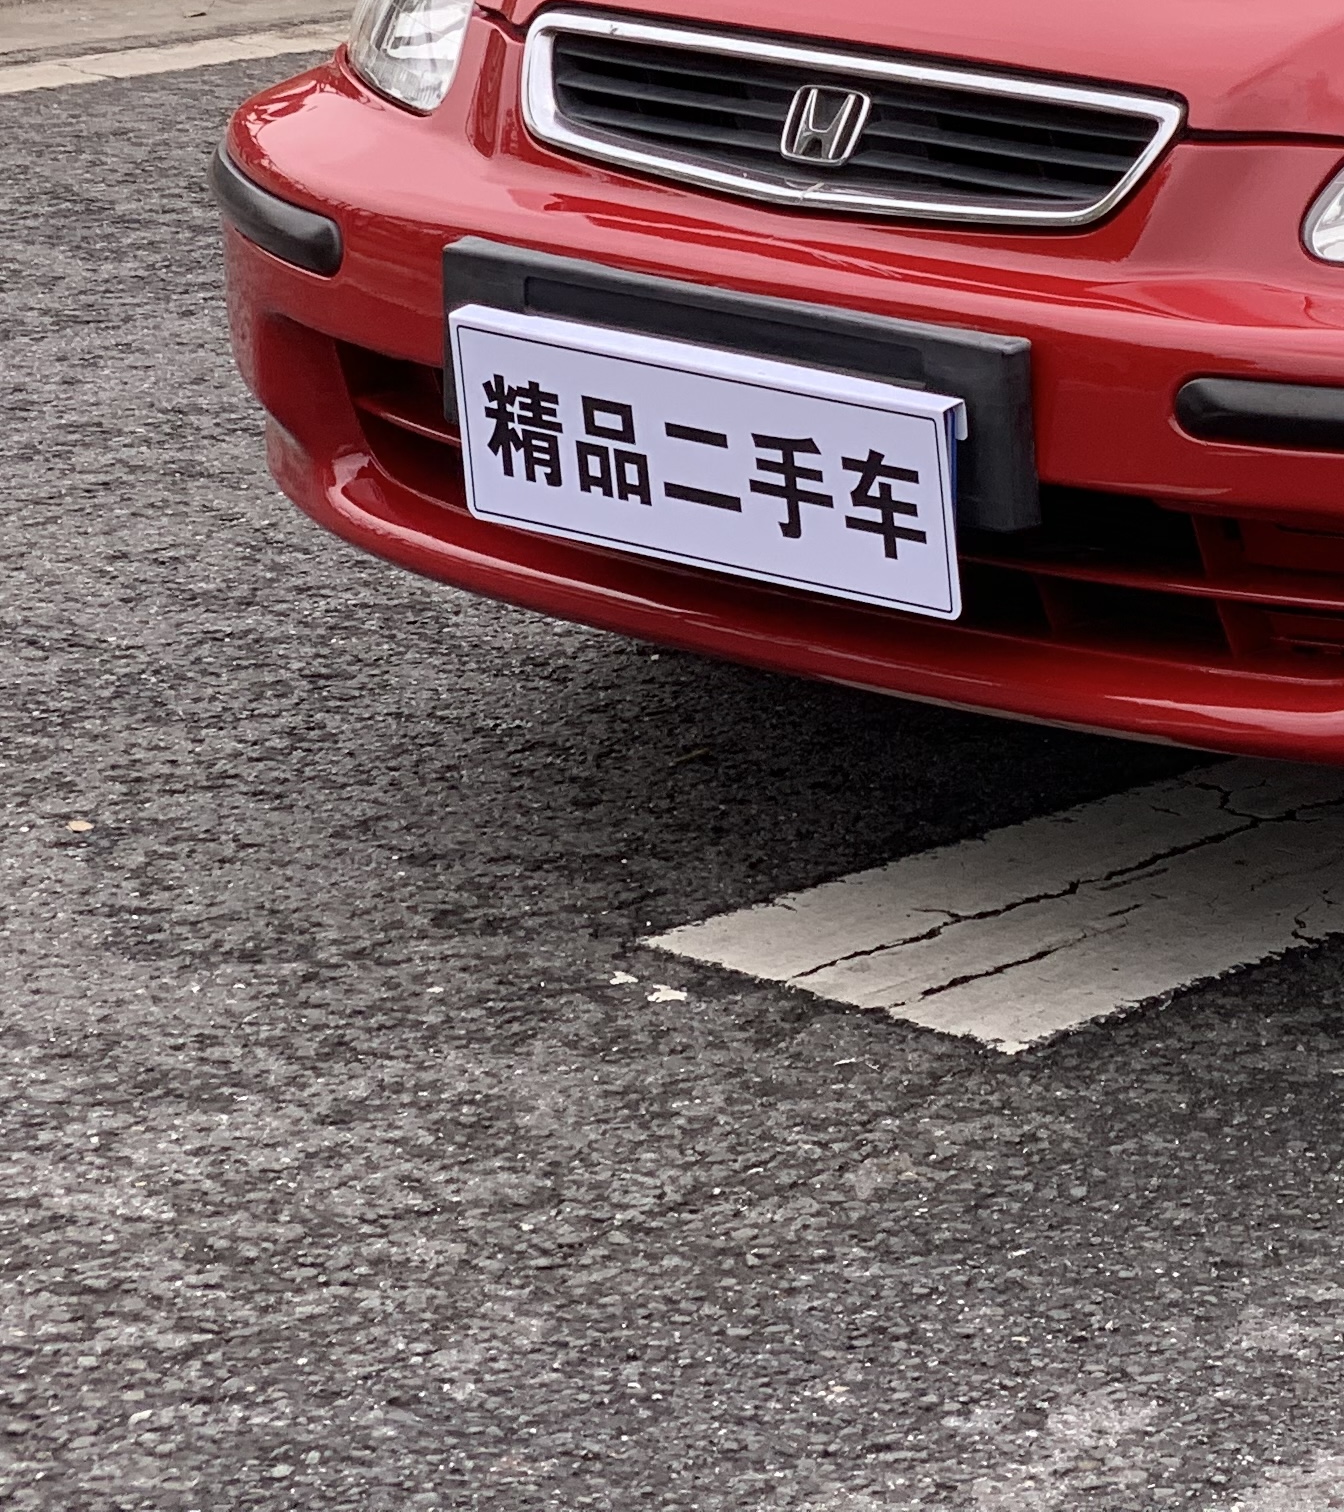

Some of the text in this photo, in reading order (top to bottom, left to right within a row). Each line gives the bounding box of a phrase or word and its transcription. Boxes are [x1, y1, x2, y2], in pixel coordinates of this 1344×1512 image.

[481, 373, 928, 560] 精品二手车
